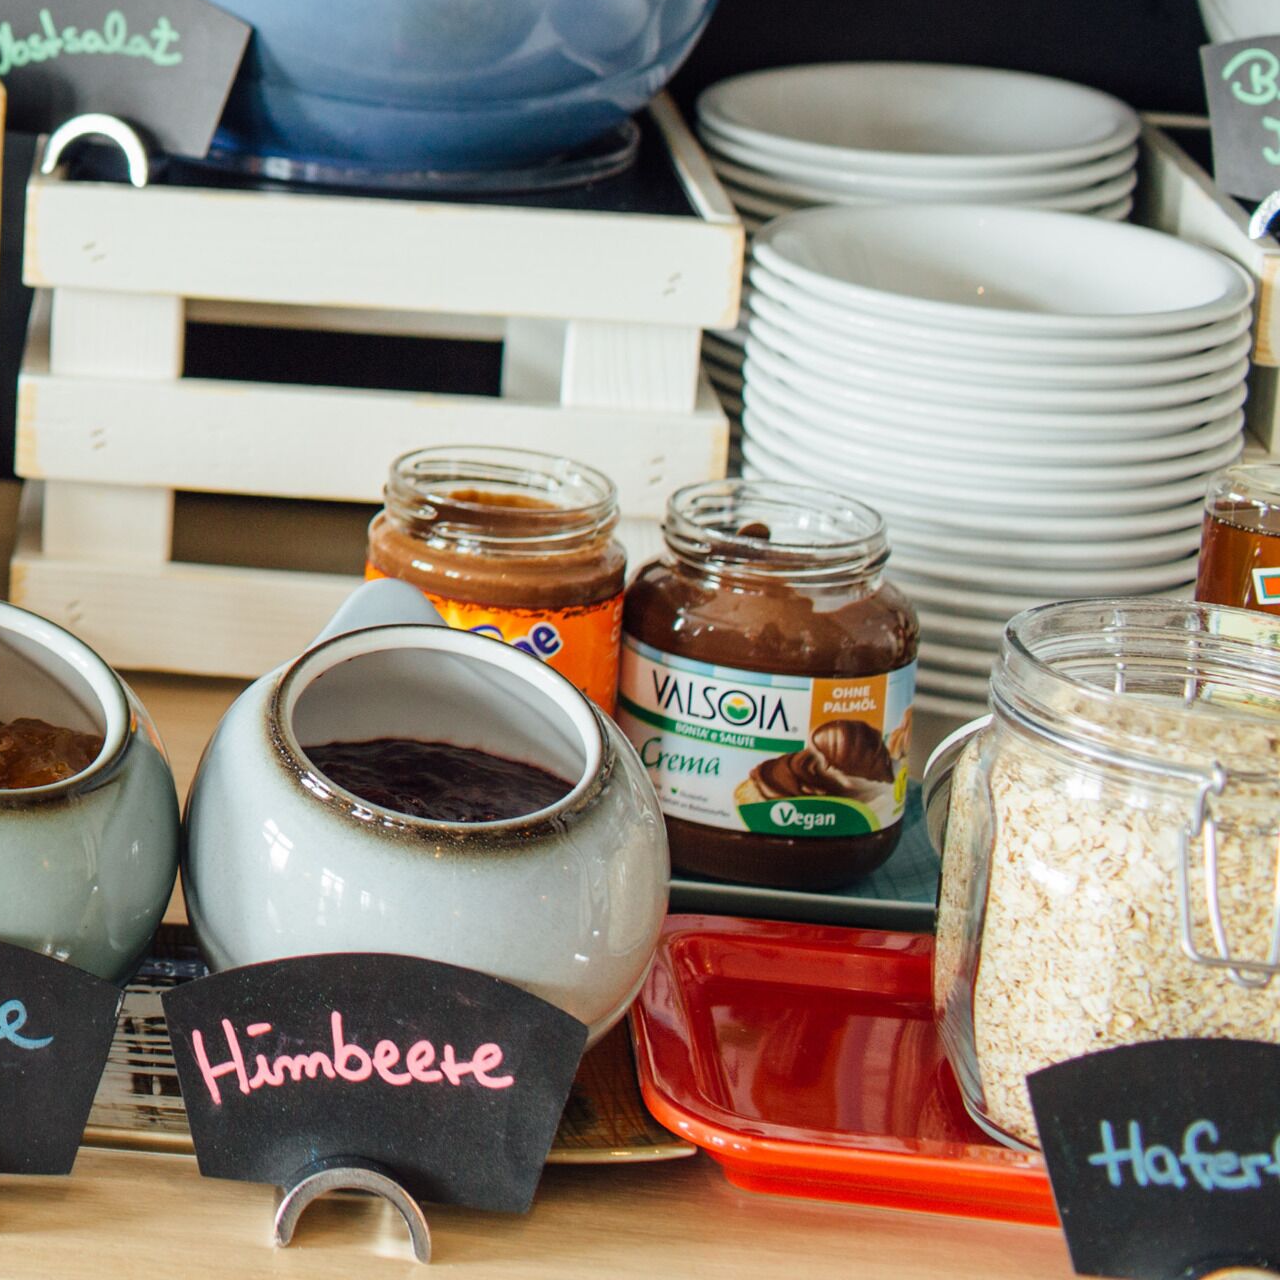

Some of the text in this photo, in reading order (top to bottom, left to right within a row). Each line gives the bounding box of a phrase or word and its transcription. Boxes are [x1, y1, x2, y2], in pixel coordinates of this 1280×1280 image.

[651, 669, 791, 733] VALSOIA
[823, 697, 877, 713] PALMÖL
[832, 685, 871, 699] OHNE
[640, 736, 720, 776] Crema
[719, 731, 756, 748] SALUTE
[776, 804, 836, 830] Vegan
[191, 1010, 515, 1105] Himbeere
[1088, 1120, 1280, 1192] Hafer
